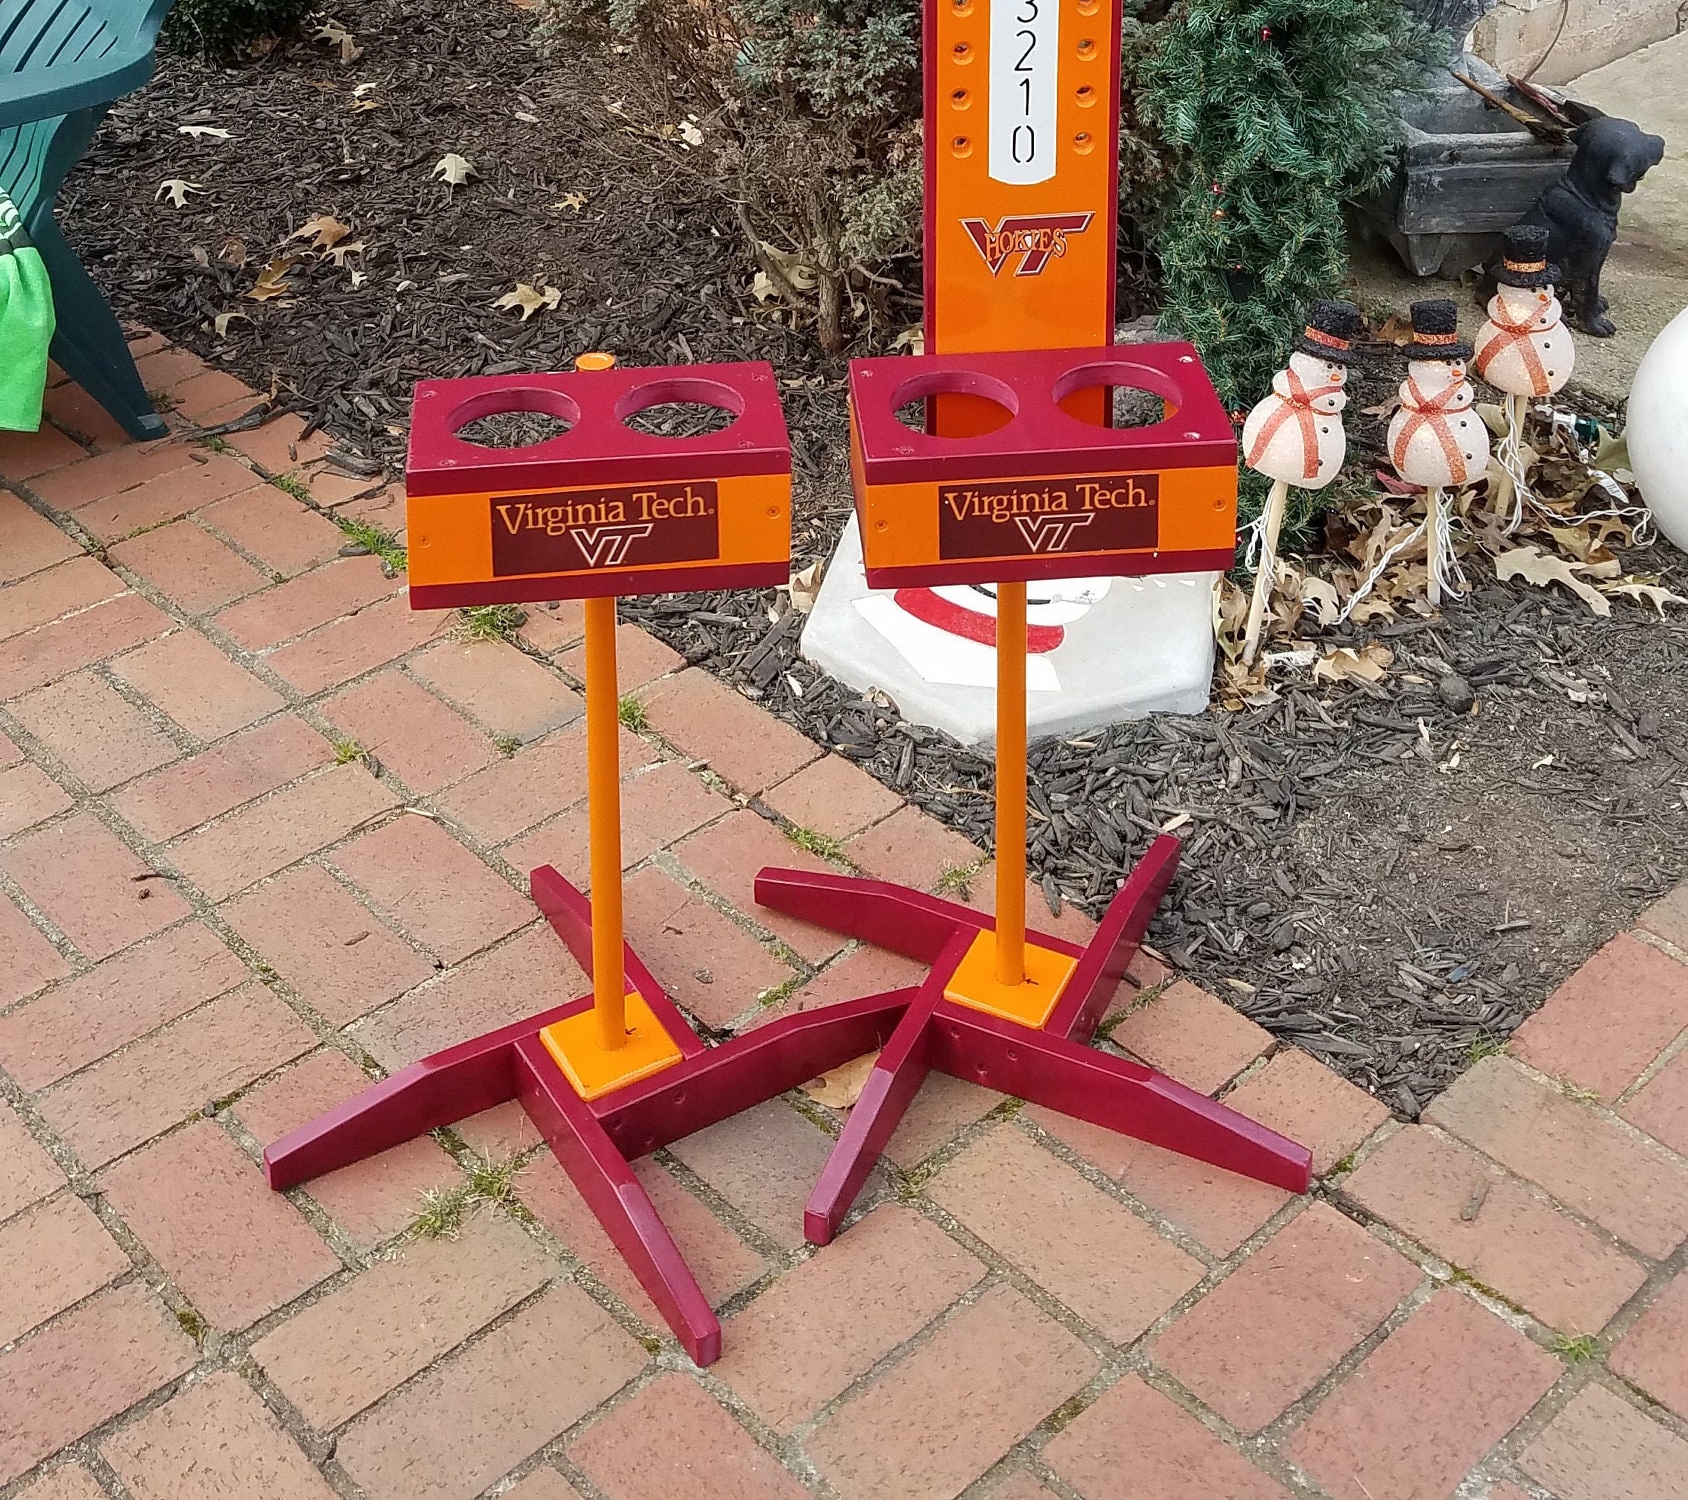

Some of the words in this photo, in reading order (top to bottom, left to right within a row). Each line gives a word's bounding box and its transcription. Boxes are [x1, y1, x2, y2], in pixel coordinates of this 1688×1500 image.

[1013, 29, 1037, 72] 2
[1019, 77, 1030, 116] 1
[1012, 124, 1035, 164] 0
[983, 227, 1068, 263] HOKIES
[496, 496, 626, 537] Virginia
[944, 487, 1069, 524] Virginia
[569, 522, 655, 568] VT
[1013, 512, 1097, 553] VT
